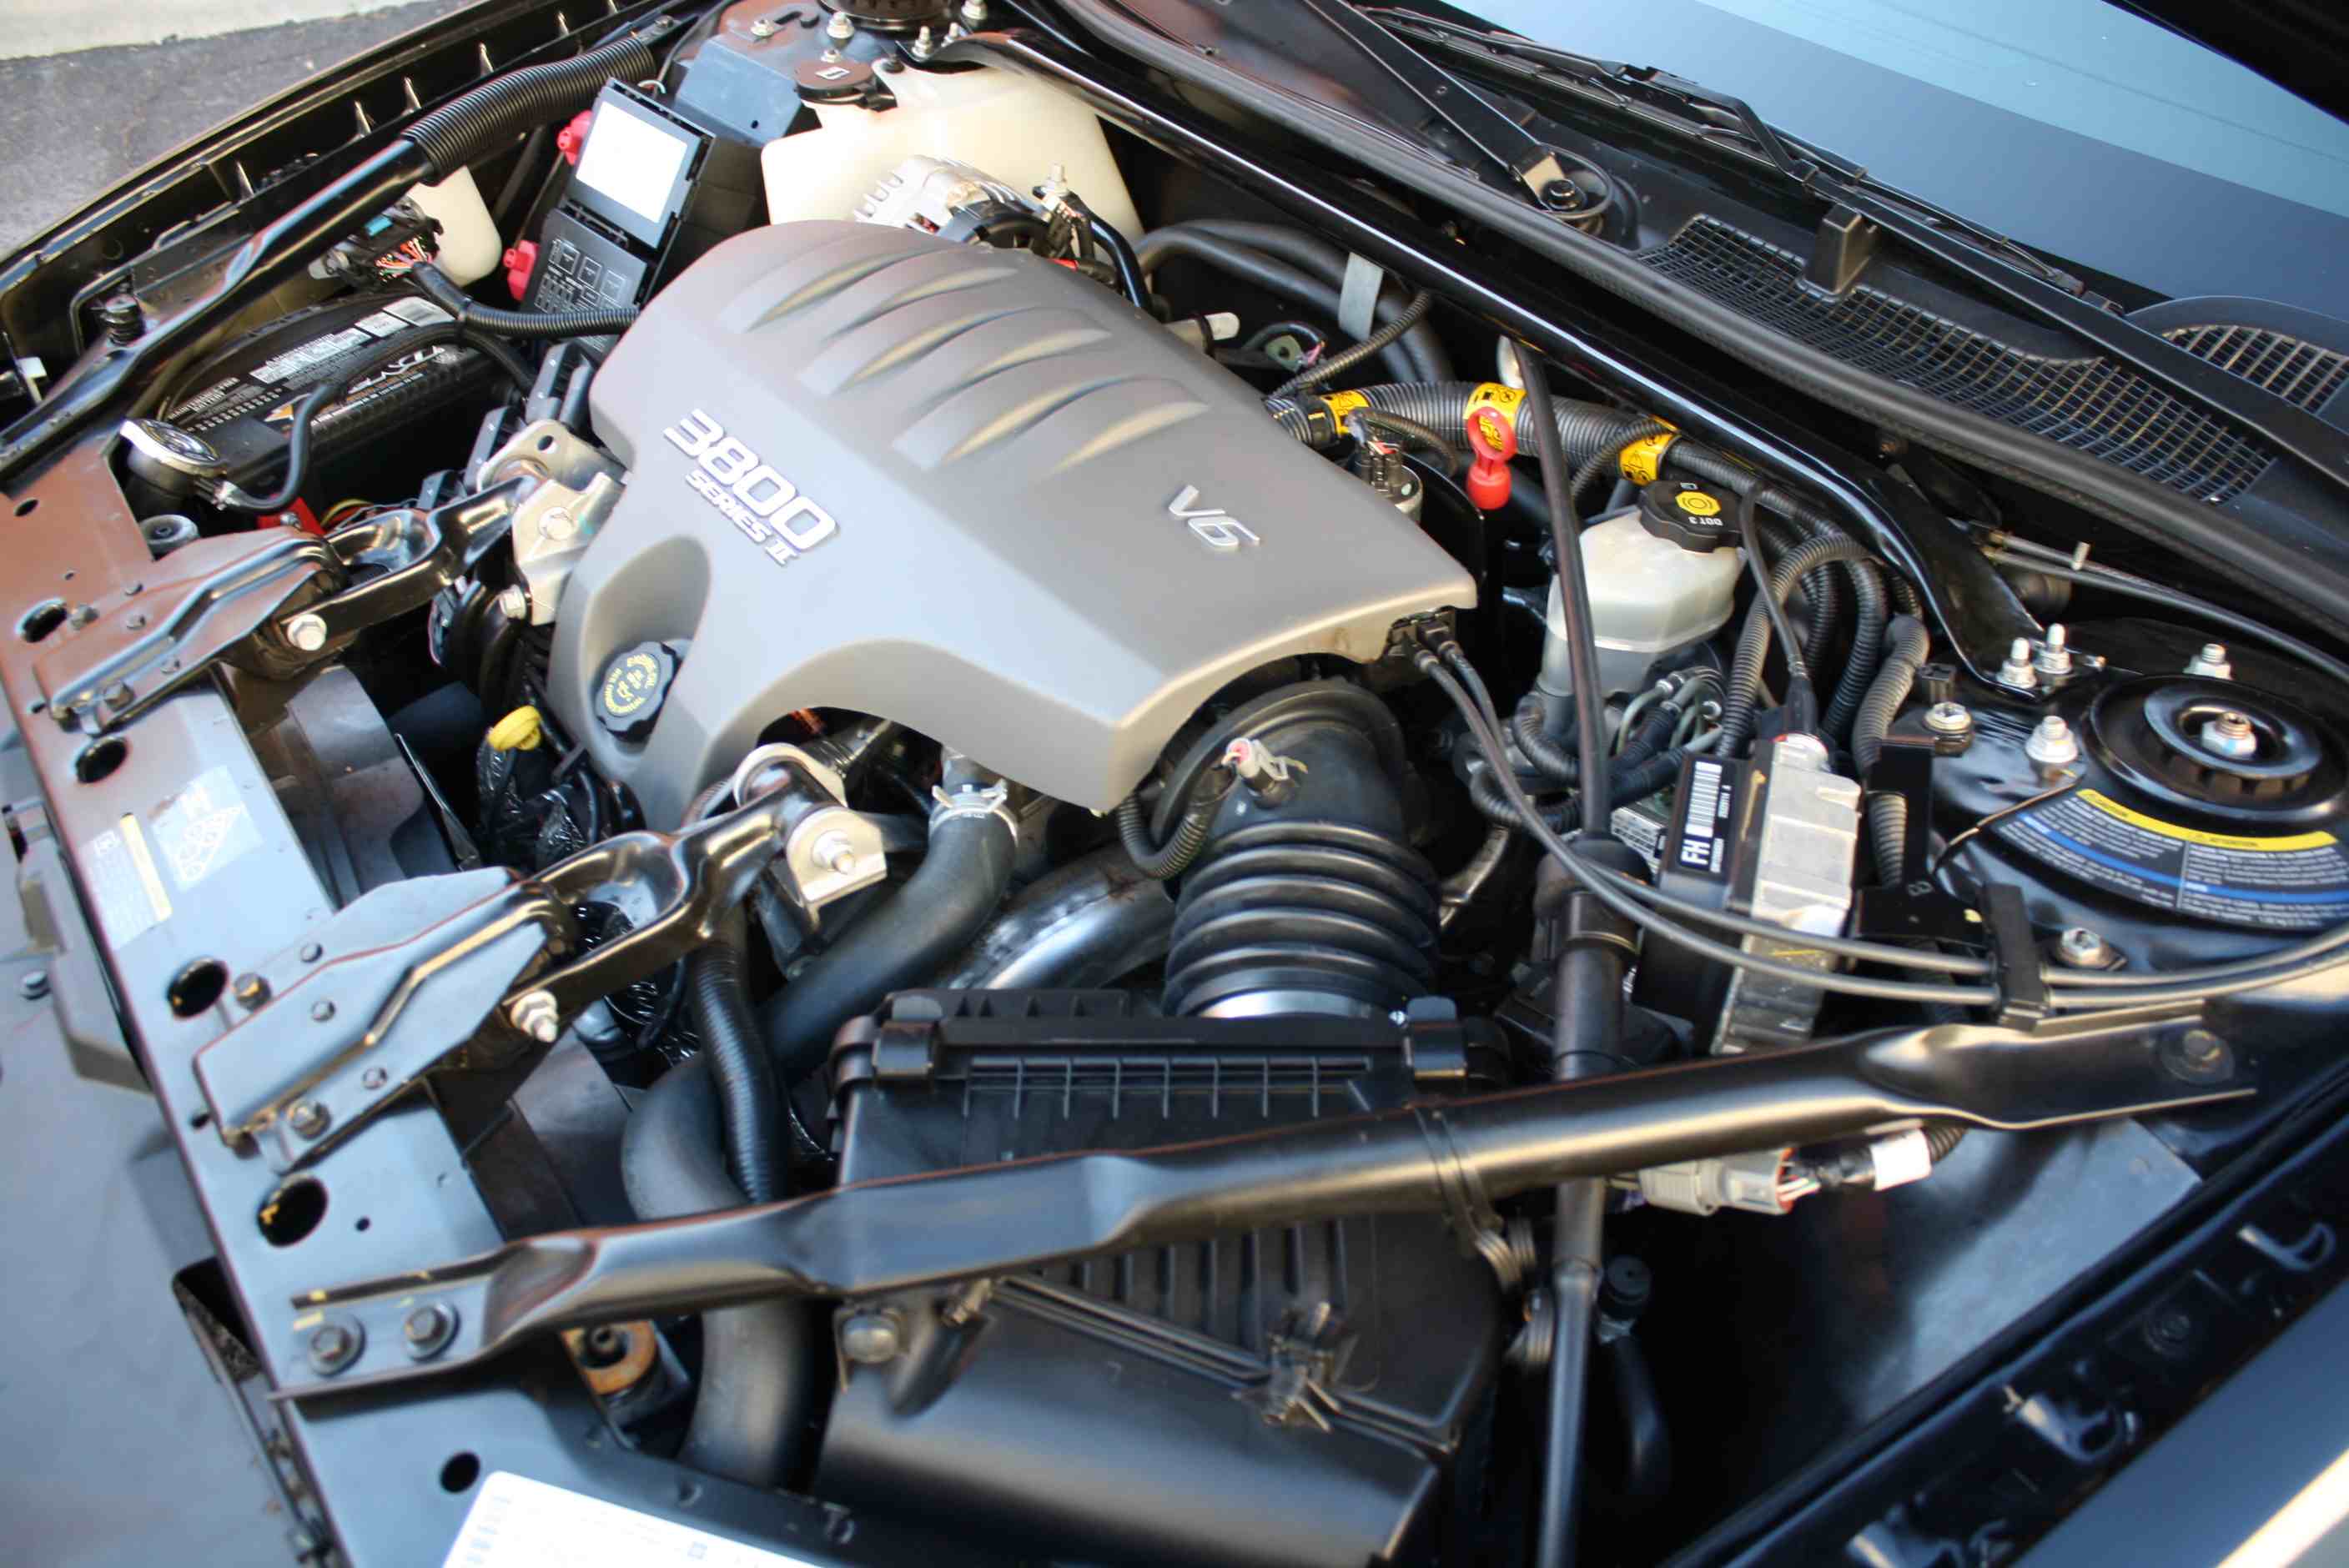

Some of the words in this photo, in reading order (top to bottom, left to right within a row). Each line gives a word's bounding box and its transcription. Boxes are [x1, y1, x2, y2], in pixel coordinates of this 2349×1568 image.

[663, 408, 837, 550] 3800
[684, 469, 774, 544] SERIES
[765, 539, 799, 566] II
[1169, 484, 1260, 548] V6
[1688, 516, 1698, 525] 3
[1700, 517, 1723, 526] DOT
[1680, 838, 1711, 866] FH
